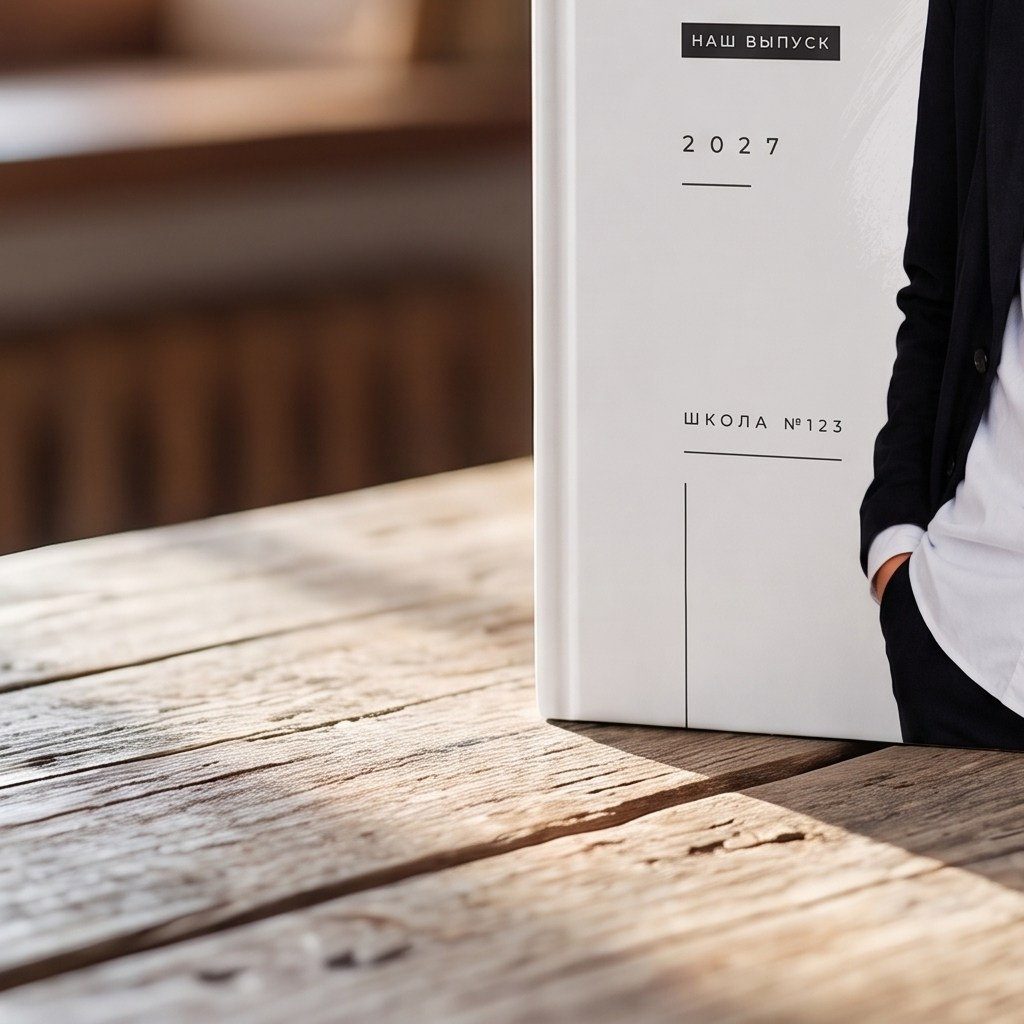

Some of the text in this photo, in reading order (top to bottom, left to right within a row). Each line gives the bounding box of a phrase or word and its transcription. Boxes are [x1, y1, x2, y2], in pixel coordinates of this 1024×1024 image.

[691, 34, 830, 51] НАШ ВЫПУСК
[682, 134, 780, 156] 2027
[684, 411, 843, 434] ШКОЛА №123
